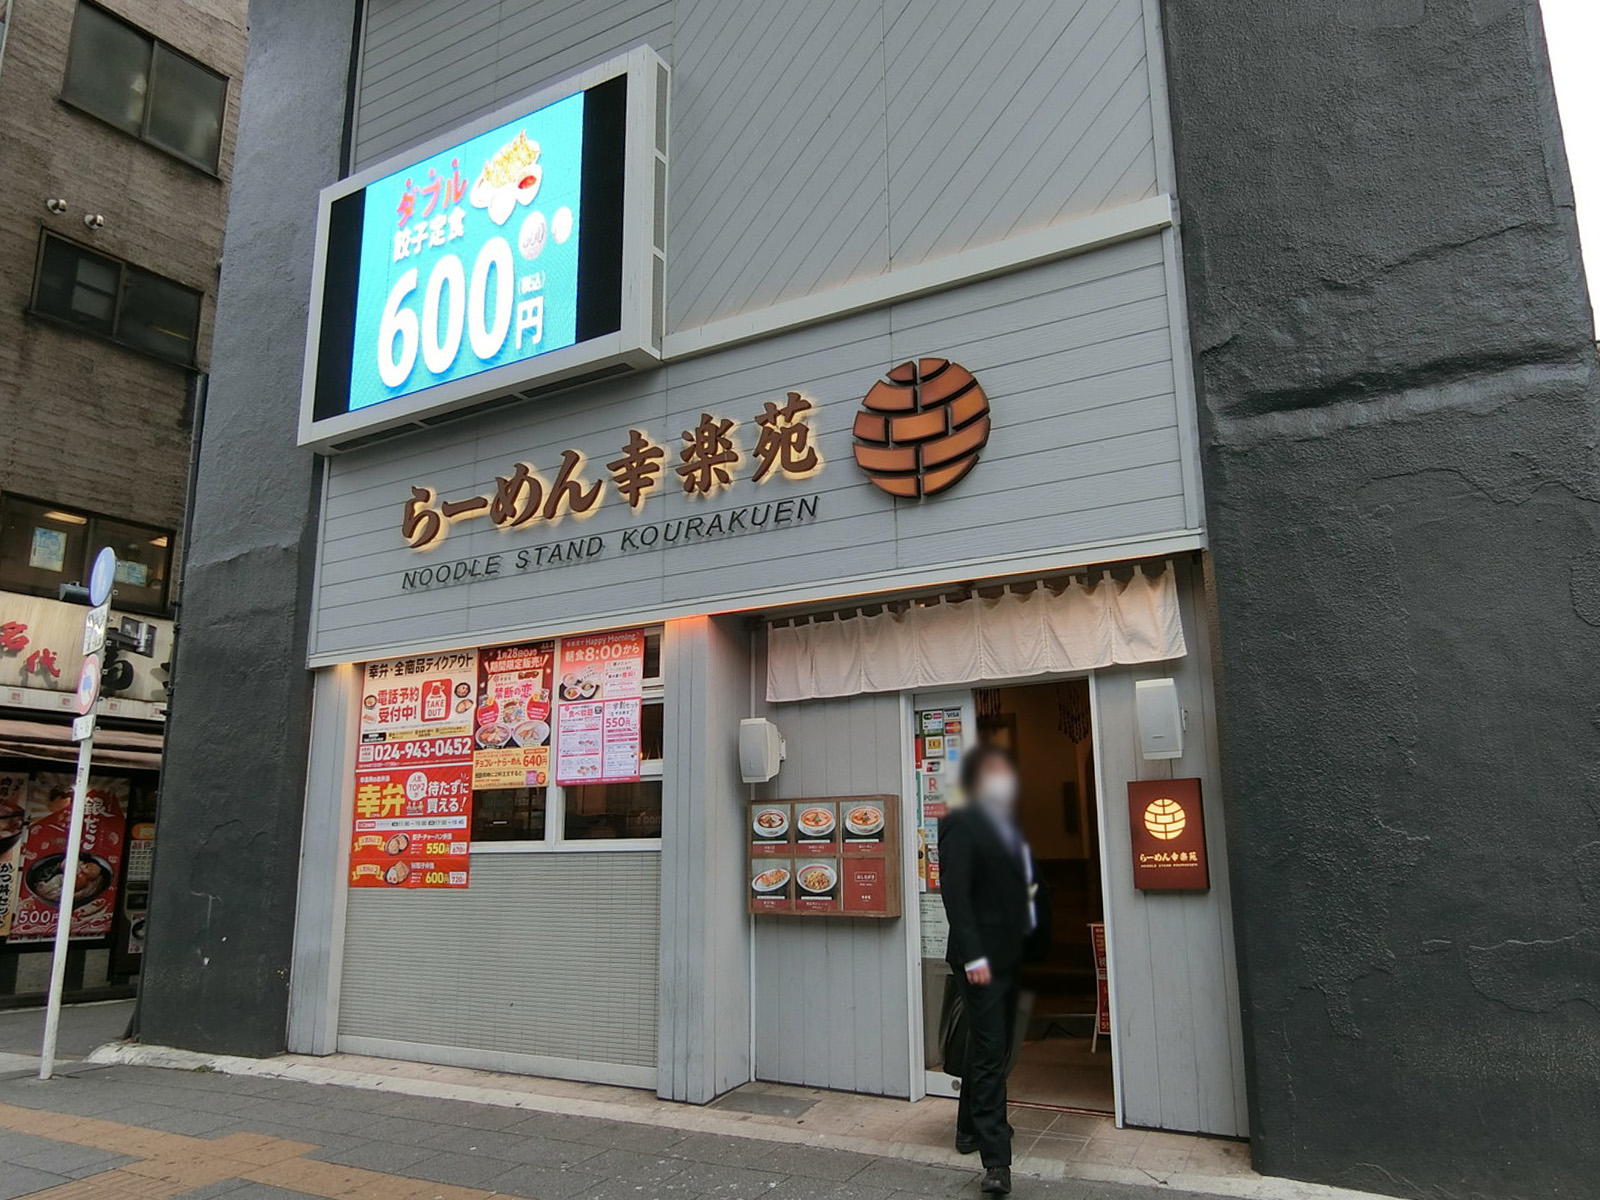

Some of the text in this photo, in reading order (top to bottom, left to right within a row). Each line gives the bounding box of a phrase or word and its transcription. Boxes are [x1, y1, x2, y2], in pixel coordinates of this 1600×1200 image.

[396, 160, 468, 228] ダブル
[393, 206, 466, 262] 餃子定食
[377, 237, 544, 388] 600 円
[401, 391, 820, 550] らーめん幸楽苑
[401, 494, 820, 590] NOODLE STAND KOURAKUEN
[377, 686, 420, 706] 電話予約
[427, 699, 445, 708] TAKE
[378, 705, 418, 723] 受付中!
[427, 708, 442, 717] OUT
[374, 737, 471, 762] 024-943-0452
[409, 783, 425, 791] TOP2
[428, 779, 470, 797] 待たずに
[357, 783, 406, 817] 幸弁
[427, 797, 467, 813] 買える!
